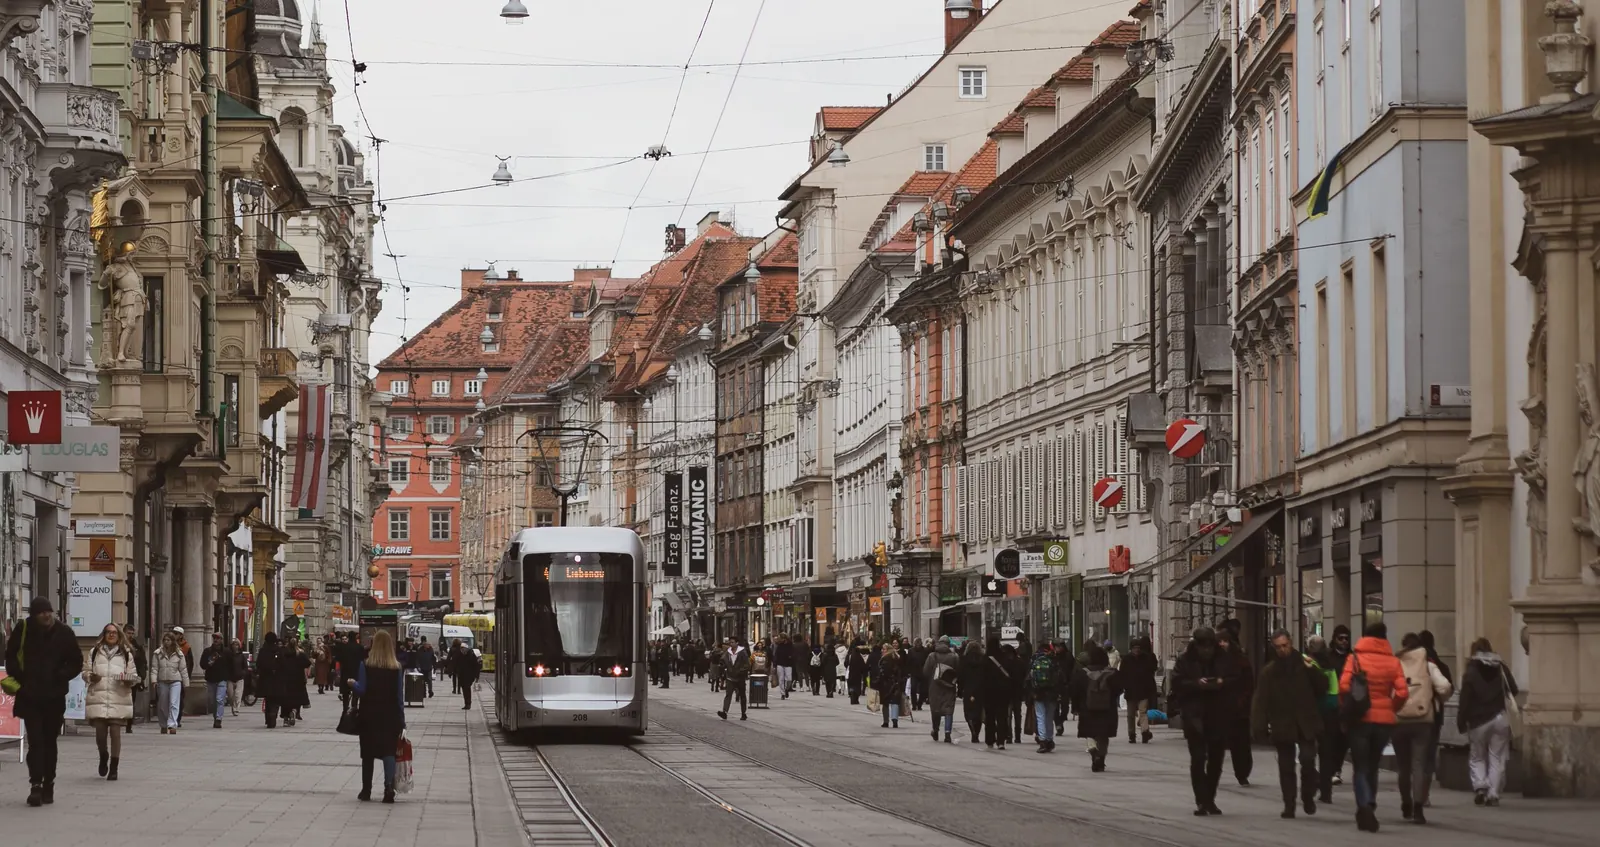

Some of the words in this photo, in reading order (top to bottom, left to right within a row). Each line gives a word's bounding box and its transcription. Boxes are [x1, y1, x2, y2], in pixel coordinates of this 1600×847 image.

[41, 442, 108, 456] DOUGLAS
[667, 484, 679, 528] Franz.
[691, 479, 705, 560] HUMANIC
[384, 546, 412, 554] GRAWE
[667, 533, 681, 565] Frag
[566, 567, 604, 578] Liebenau
[408, 626, 420, 638] GLS
[572, 714, 588, 722] 208
